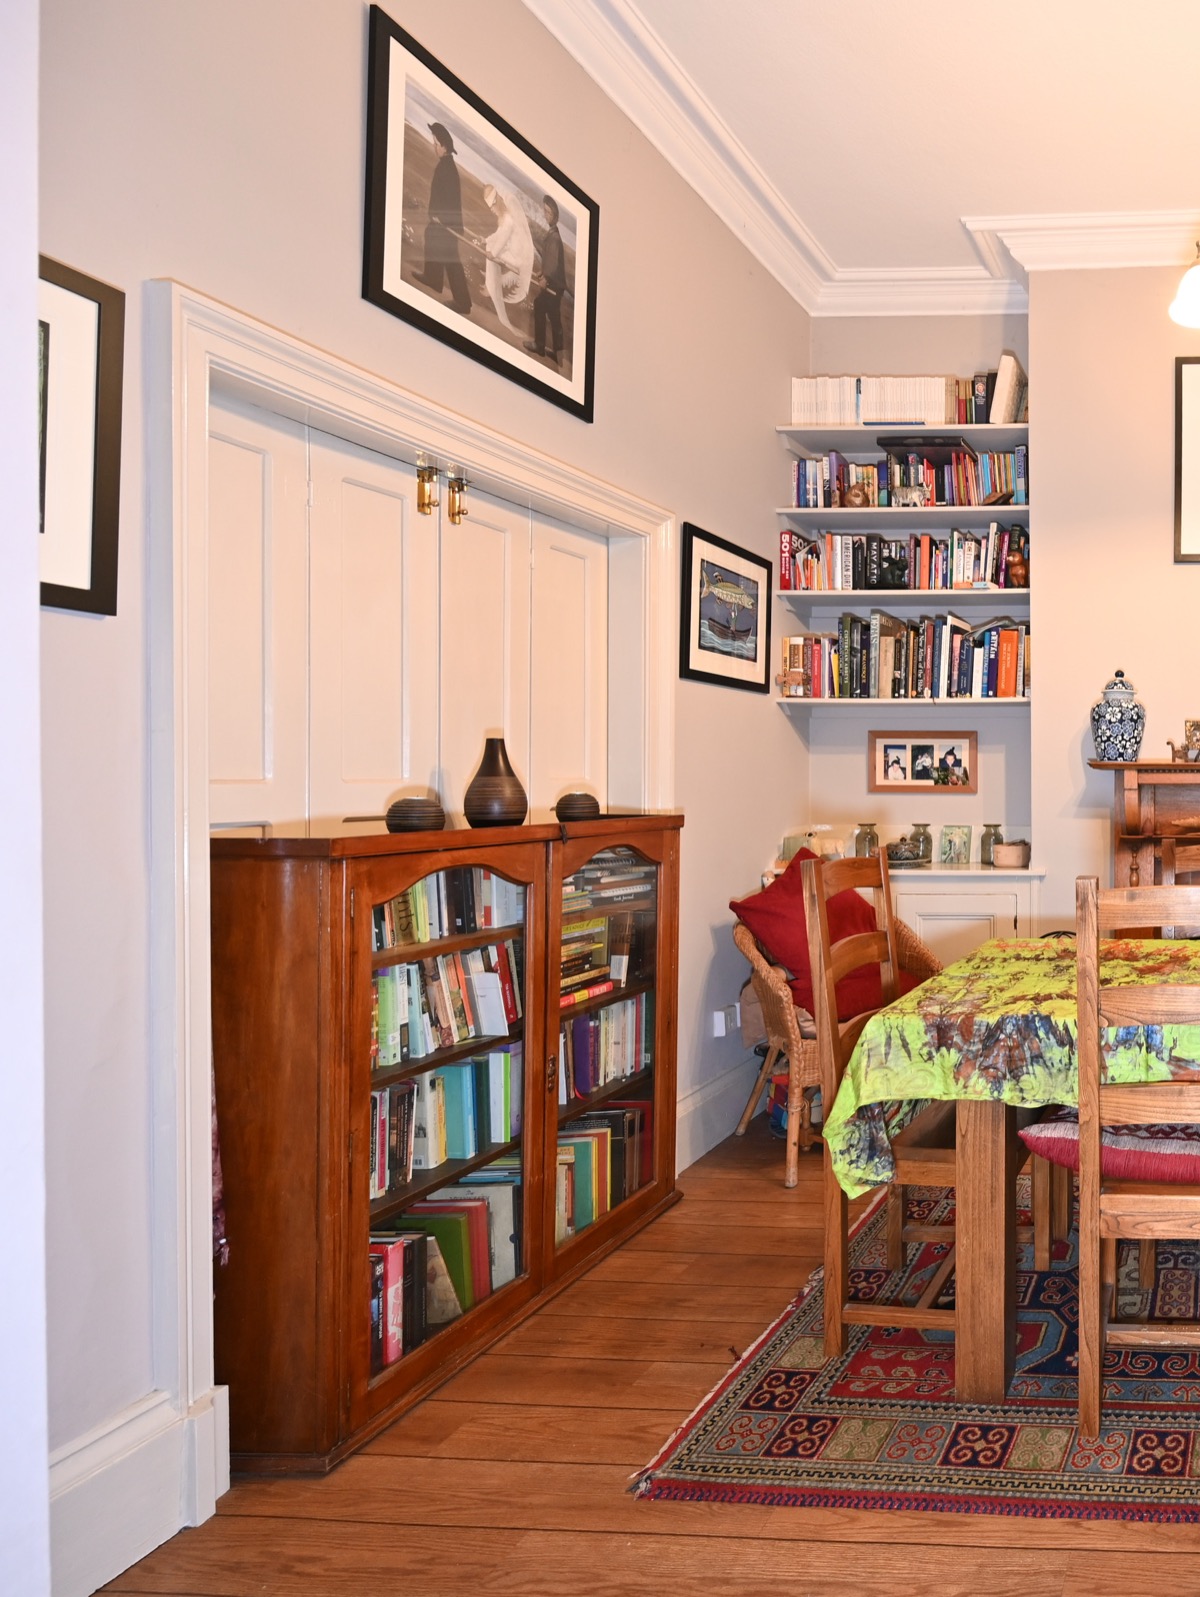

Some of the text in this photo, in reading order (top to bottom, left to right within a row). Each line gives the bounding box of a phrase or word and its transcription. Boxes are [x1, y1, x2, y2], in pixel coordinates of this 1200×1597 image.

[782, 533, 790, 558] 501
[870, 563, 877, 574] AT
[870, 615, 879, 644] DEGAS
[990, 631, 998, 659] BRITAIN
